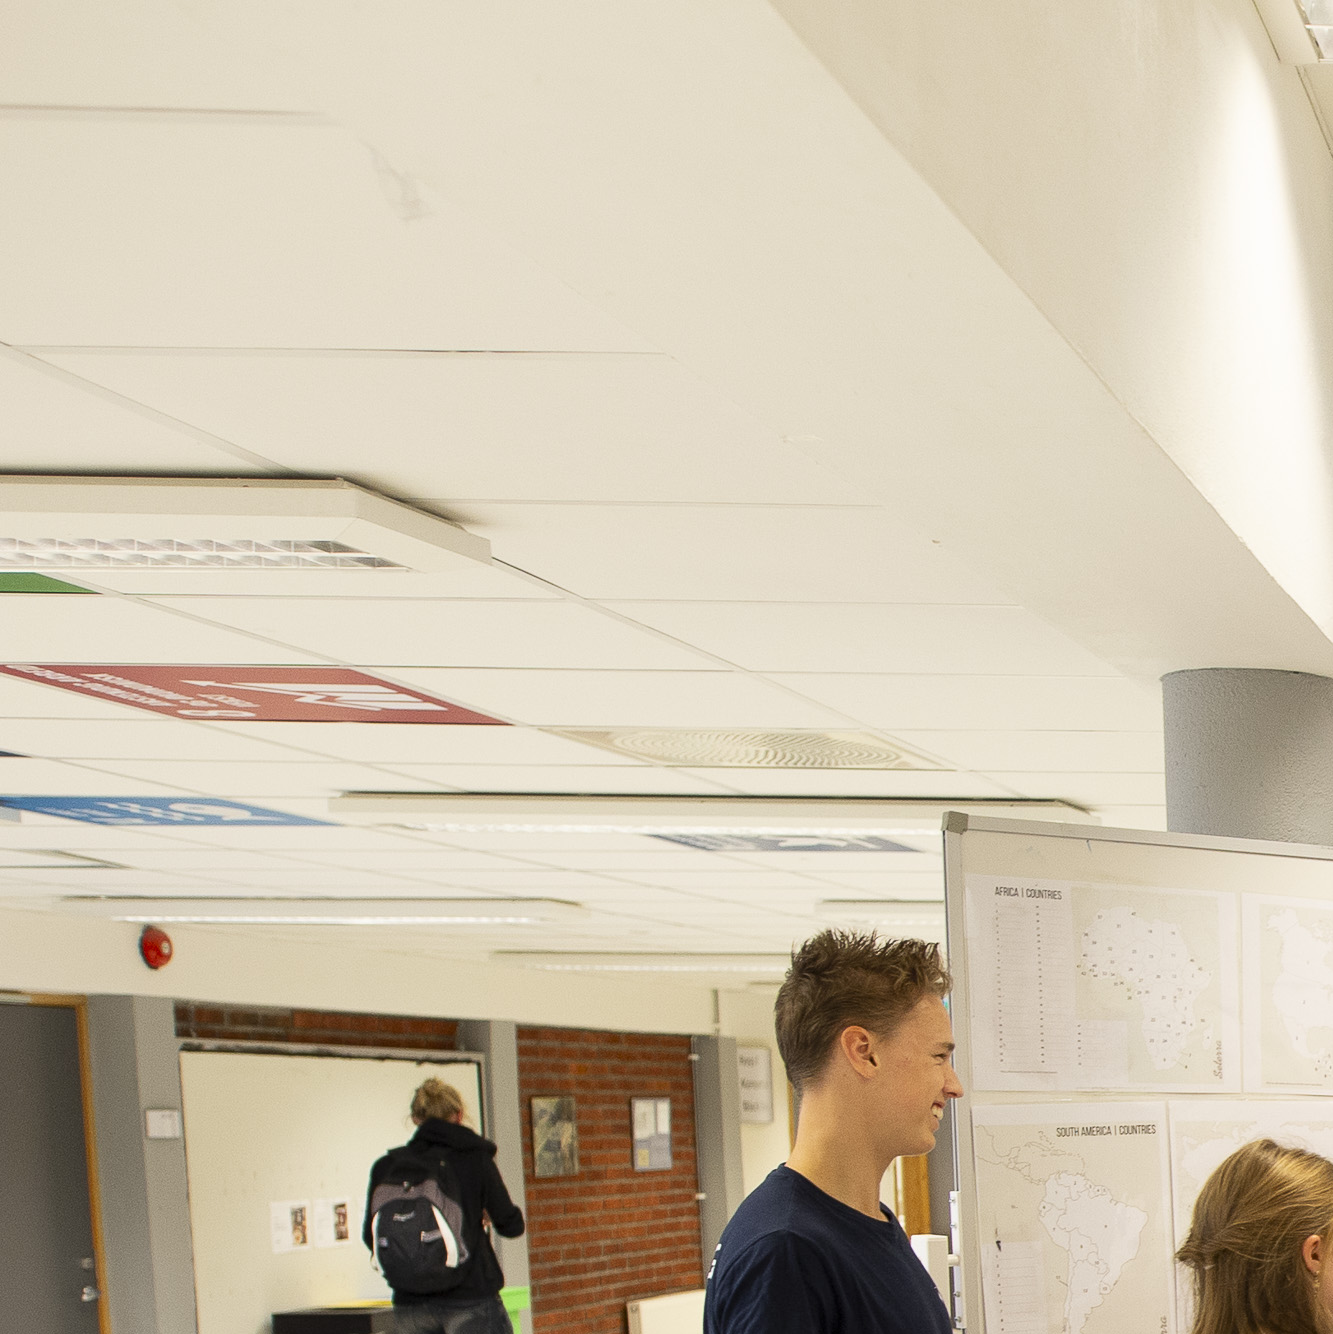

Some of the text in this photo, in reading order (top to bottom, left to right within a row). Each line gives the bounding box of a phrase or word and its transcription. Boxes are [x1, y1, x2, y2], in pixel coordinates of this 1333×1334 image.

[994, 886, 1019, 897] AFRICA
[1025, 888, 1062, 900] COUNTRIES
[1056, 1126, 1080, 1138] SOUTH
[1081, 1125, 1112, 1137] AMERICA
[1119, 1124, 1157, 1136] COUNTRIES
